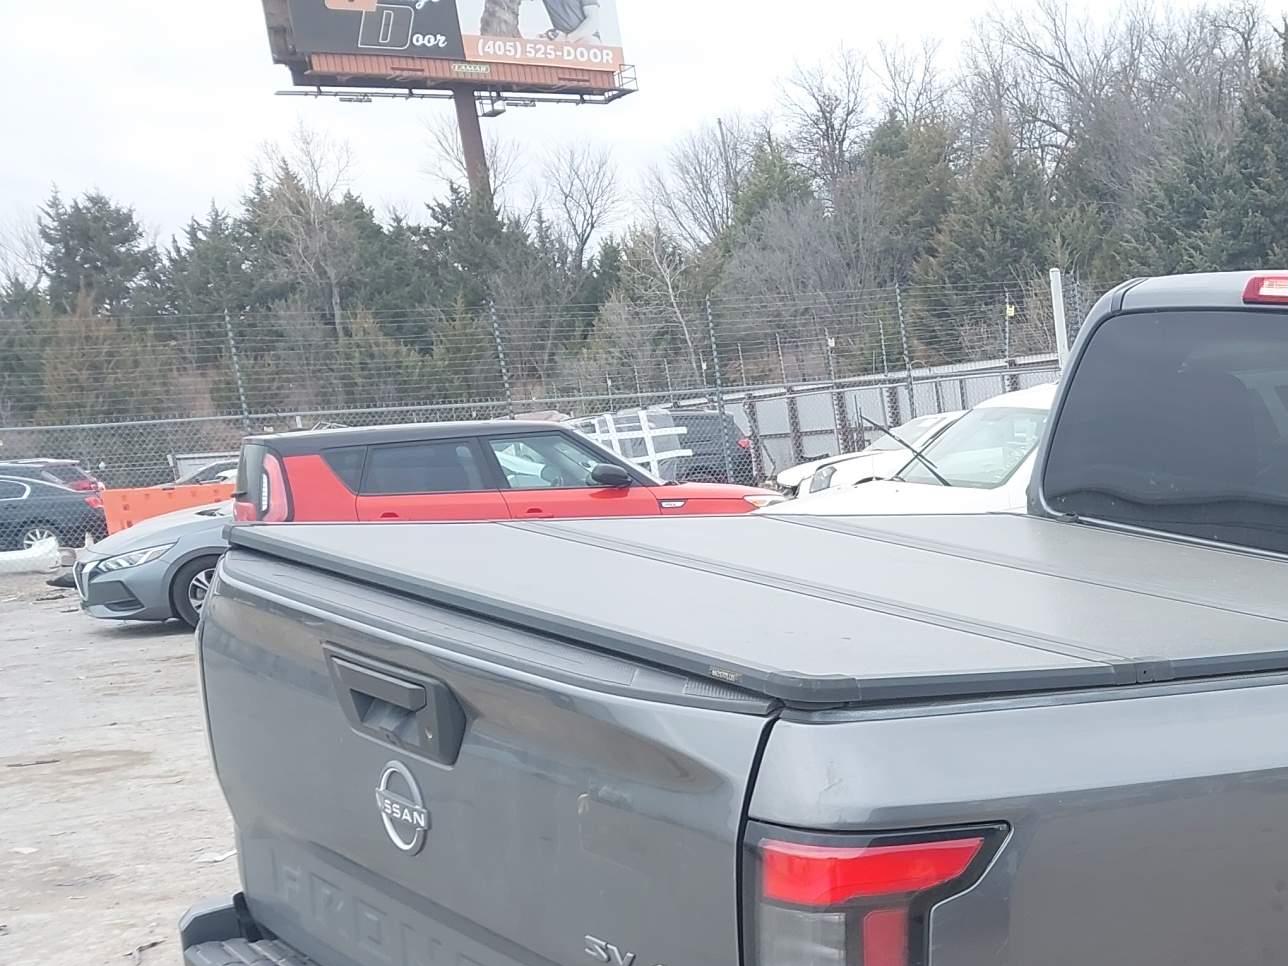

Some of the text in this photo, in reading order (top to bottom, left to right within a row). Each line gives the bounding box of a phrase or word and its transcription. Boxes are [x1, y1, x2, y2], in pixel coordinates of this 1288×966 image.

[358, 4, 448, 50] Door
[477, 38, 613, 64] (405) 525-DOOR
[453, 63, 489, 73] LAMAR
[380, 798, 426, 828] SSAN
